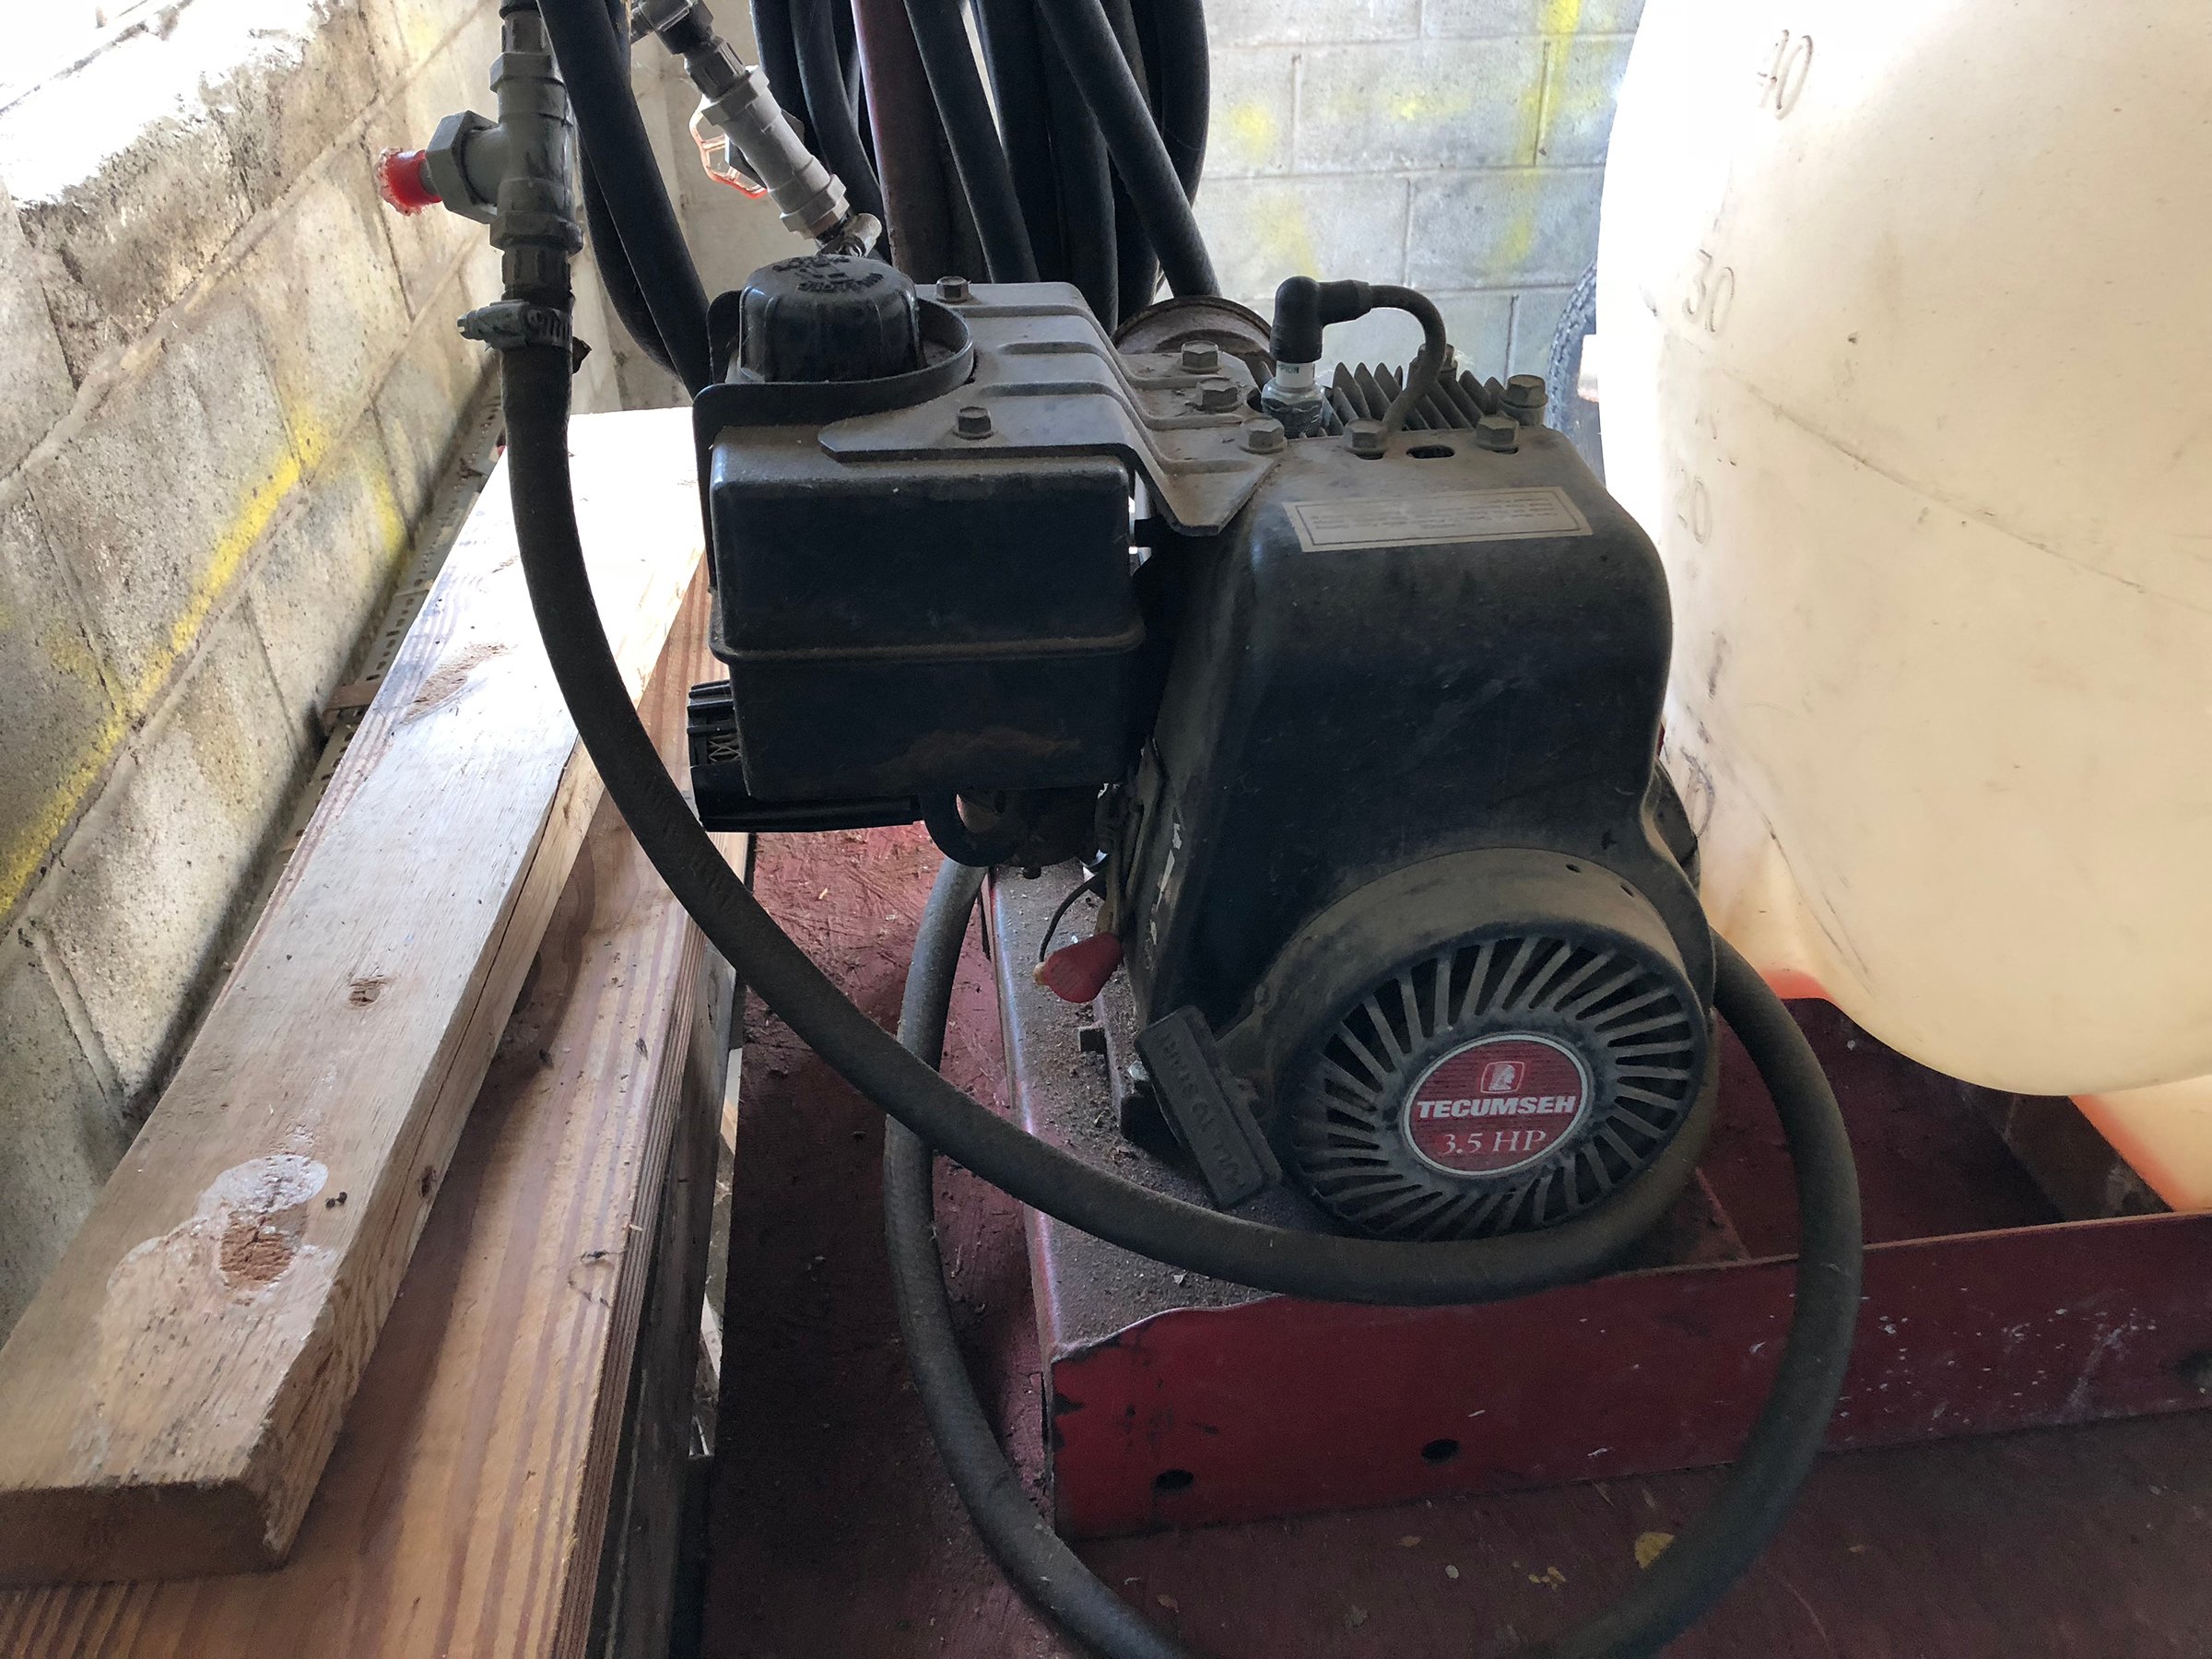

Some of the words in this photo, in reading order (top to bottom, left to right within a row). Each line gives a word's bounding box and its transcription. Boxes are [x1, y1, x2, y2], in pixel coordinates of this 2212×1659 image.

[1417, 1095, 1577, 1119] TECUMSEH
[1442, 1133, 1484, 1155] 3.5
[1492, 1130, 1547, 1152] HP
